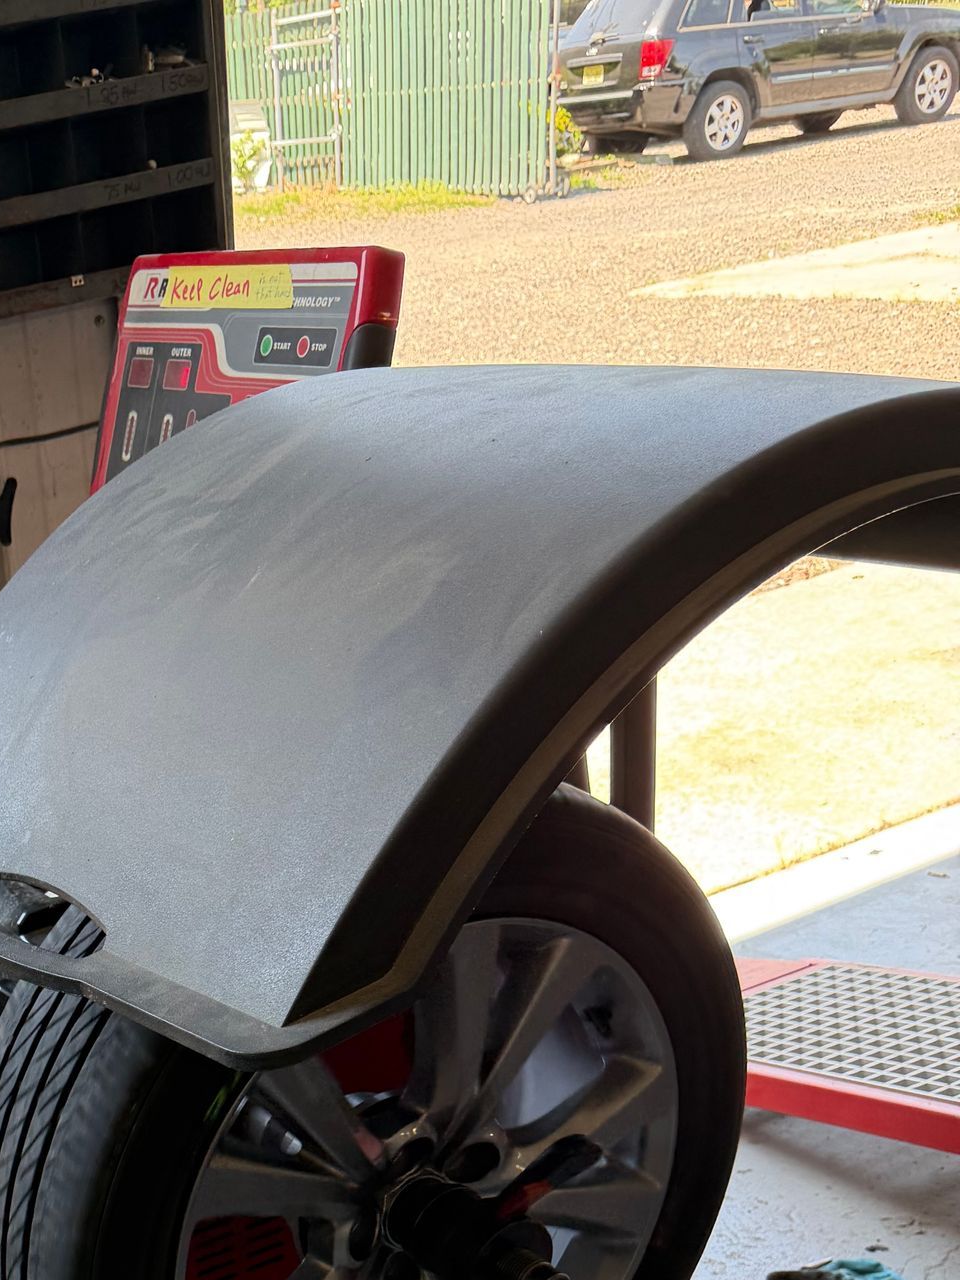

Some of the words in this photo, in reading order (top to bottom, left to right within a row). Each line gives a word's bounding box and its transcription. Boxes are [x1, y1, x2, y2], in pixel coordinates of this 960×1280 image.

[169, 276, 204, 305] Keep
[208, 273, 251, 300] Clean
[273, 341, 292, 351] START
[310, 342, 327, 352] STOP
[171, 347, 192, 357] OUTER
